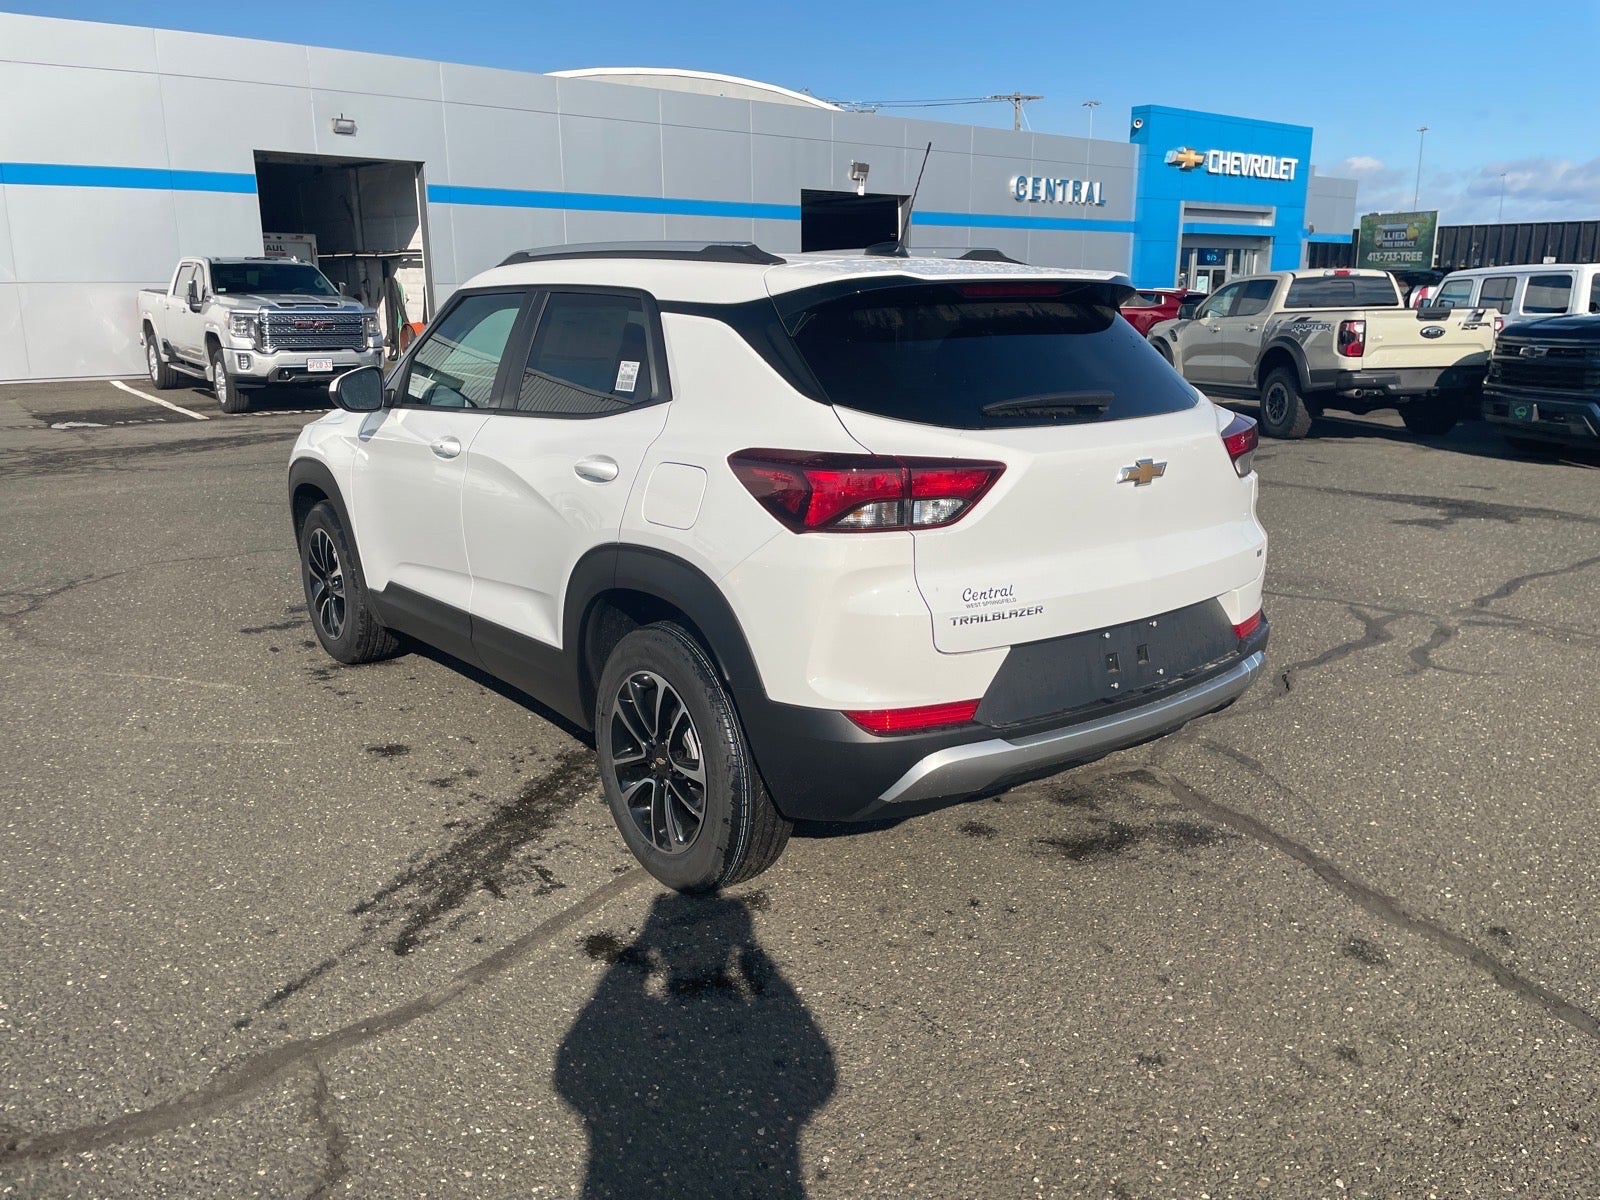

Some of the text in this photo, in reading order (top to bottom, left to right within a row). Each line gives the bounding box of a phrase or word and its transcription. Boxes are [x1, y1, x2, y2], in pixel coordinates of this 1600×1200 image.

[1207, 149, 1299, 181] CHEVROLET
[1010, 175, 1107, 207] CENTRAL
[1367, 251, 1424, 263] 413-733-TREE
[1291, 322, 1333, 334] RAPTOR
[962, 584, 1014, 602] Central
[966, 597, 1017, 609] WEST SPRINGFIELD
[950, 605, 1044, 627] TRAILBLAZER
